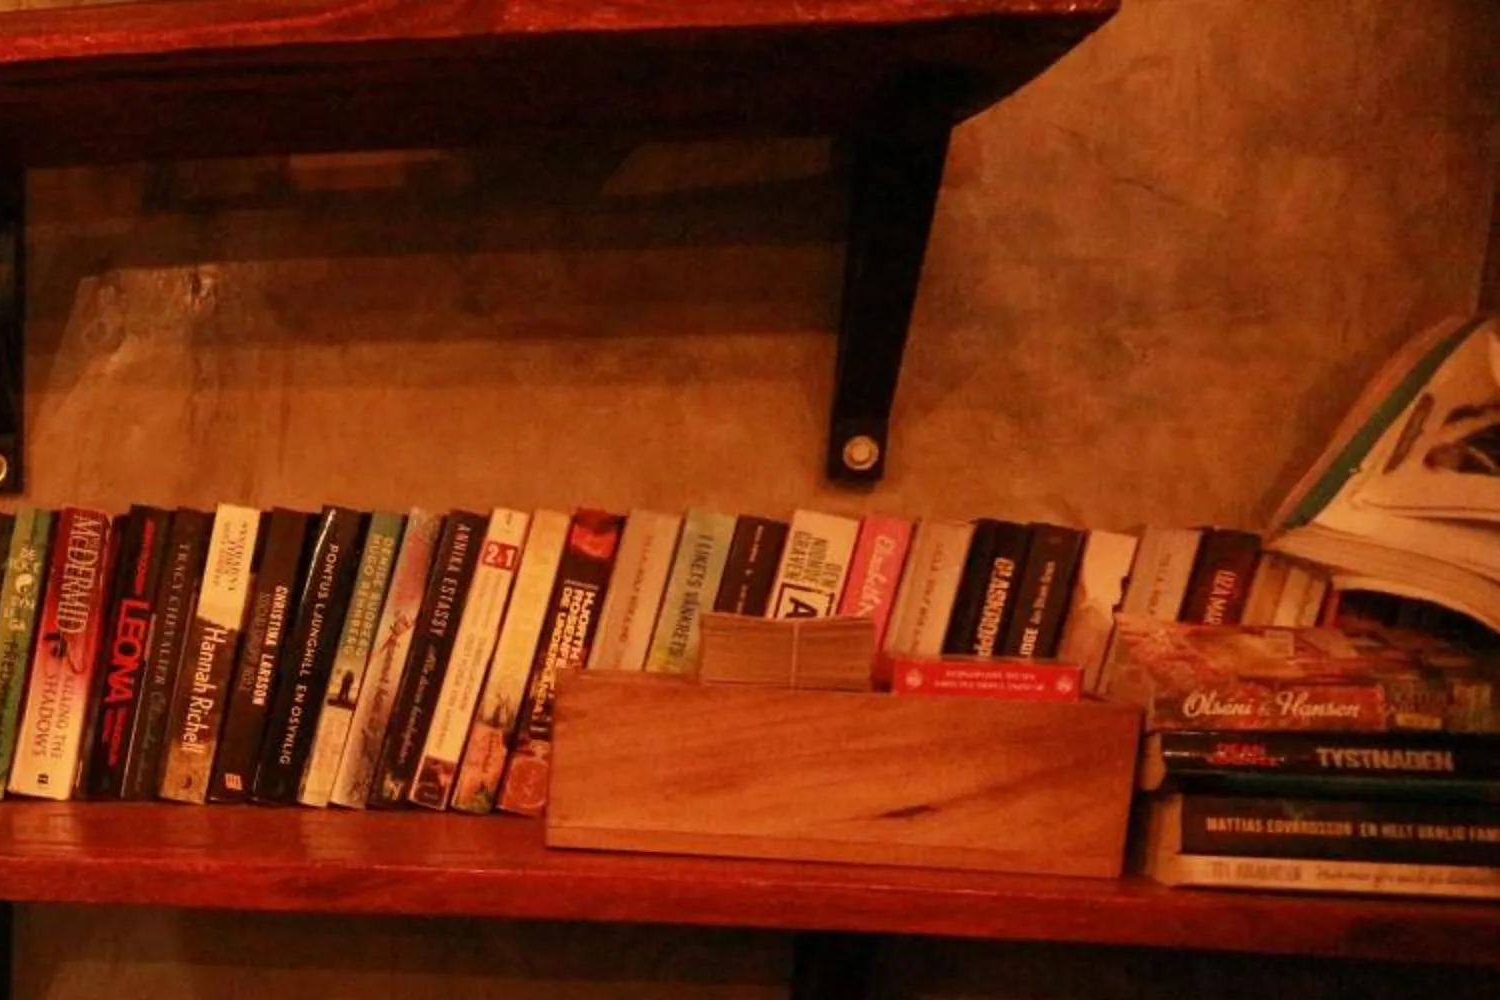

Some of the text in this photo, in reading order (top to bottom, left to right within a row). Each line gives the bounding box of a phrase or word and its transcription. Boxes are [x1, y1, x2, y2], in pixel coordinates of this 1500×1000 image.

[447, 523, 471, 572] ANNIKA
[110, 601, 147, 702] LEONA
[279, 543, 340, 765] PONTUS LJUNGHILL EN OSYNLIG
[32, 667, 61, 756] SHADOWS
[179, 627, 228, 755] Hannah Richell
[1276, 690, 1360, 717] Hansen
[1317, 747, 1452, 770] TYSTNADEN
[1206, 817, 1263, 833] MATTIAS
